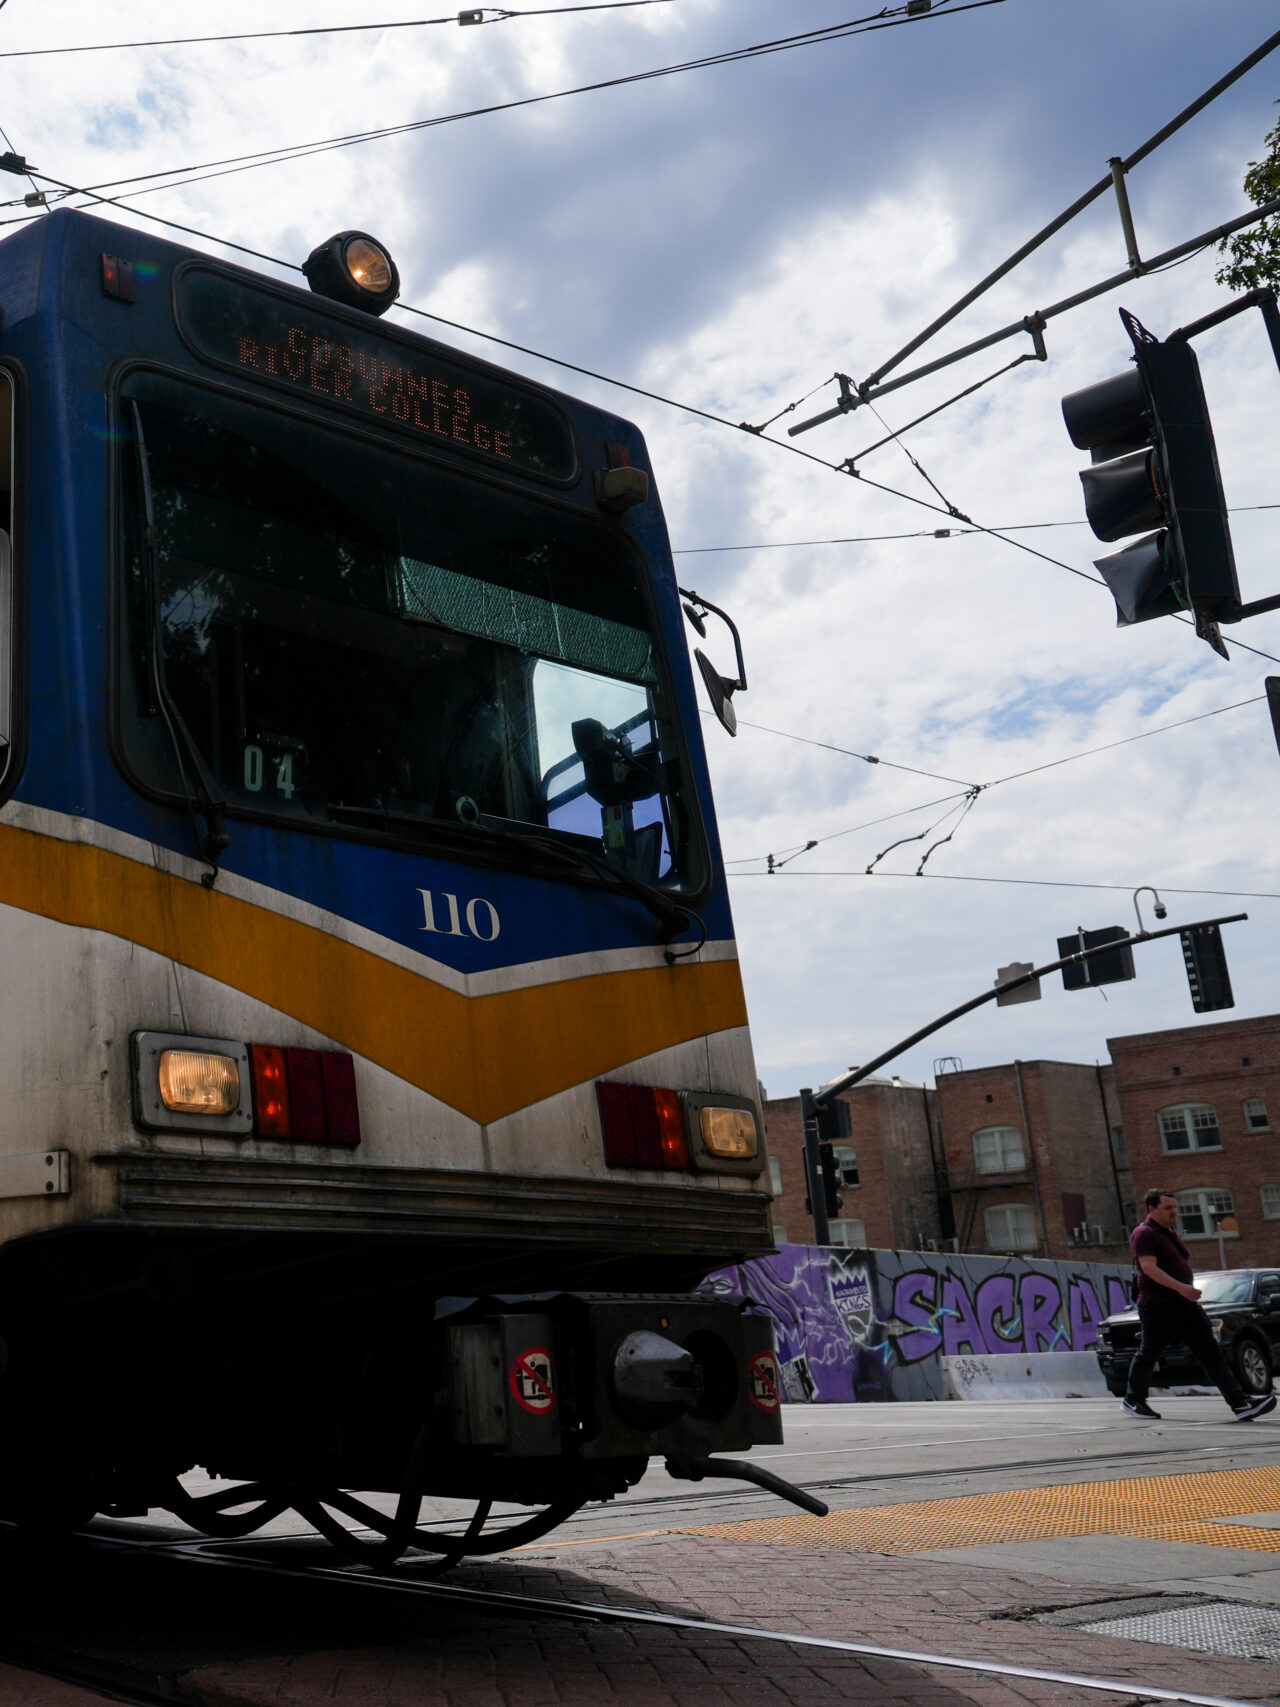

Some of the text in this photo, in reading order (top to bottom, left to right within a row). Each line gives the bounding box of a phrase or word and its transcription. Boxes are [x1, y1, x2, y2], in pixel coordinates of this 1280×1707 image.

[239, 336, 512, 458] RIVER COLLEGE
[288, 327, 471, 416] COSUMNES
[243, 744, 295, 800] 04
[416, 888, 501, 942] 110
[835, 1294, 872, 1312] KINGS
